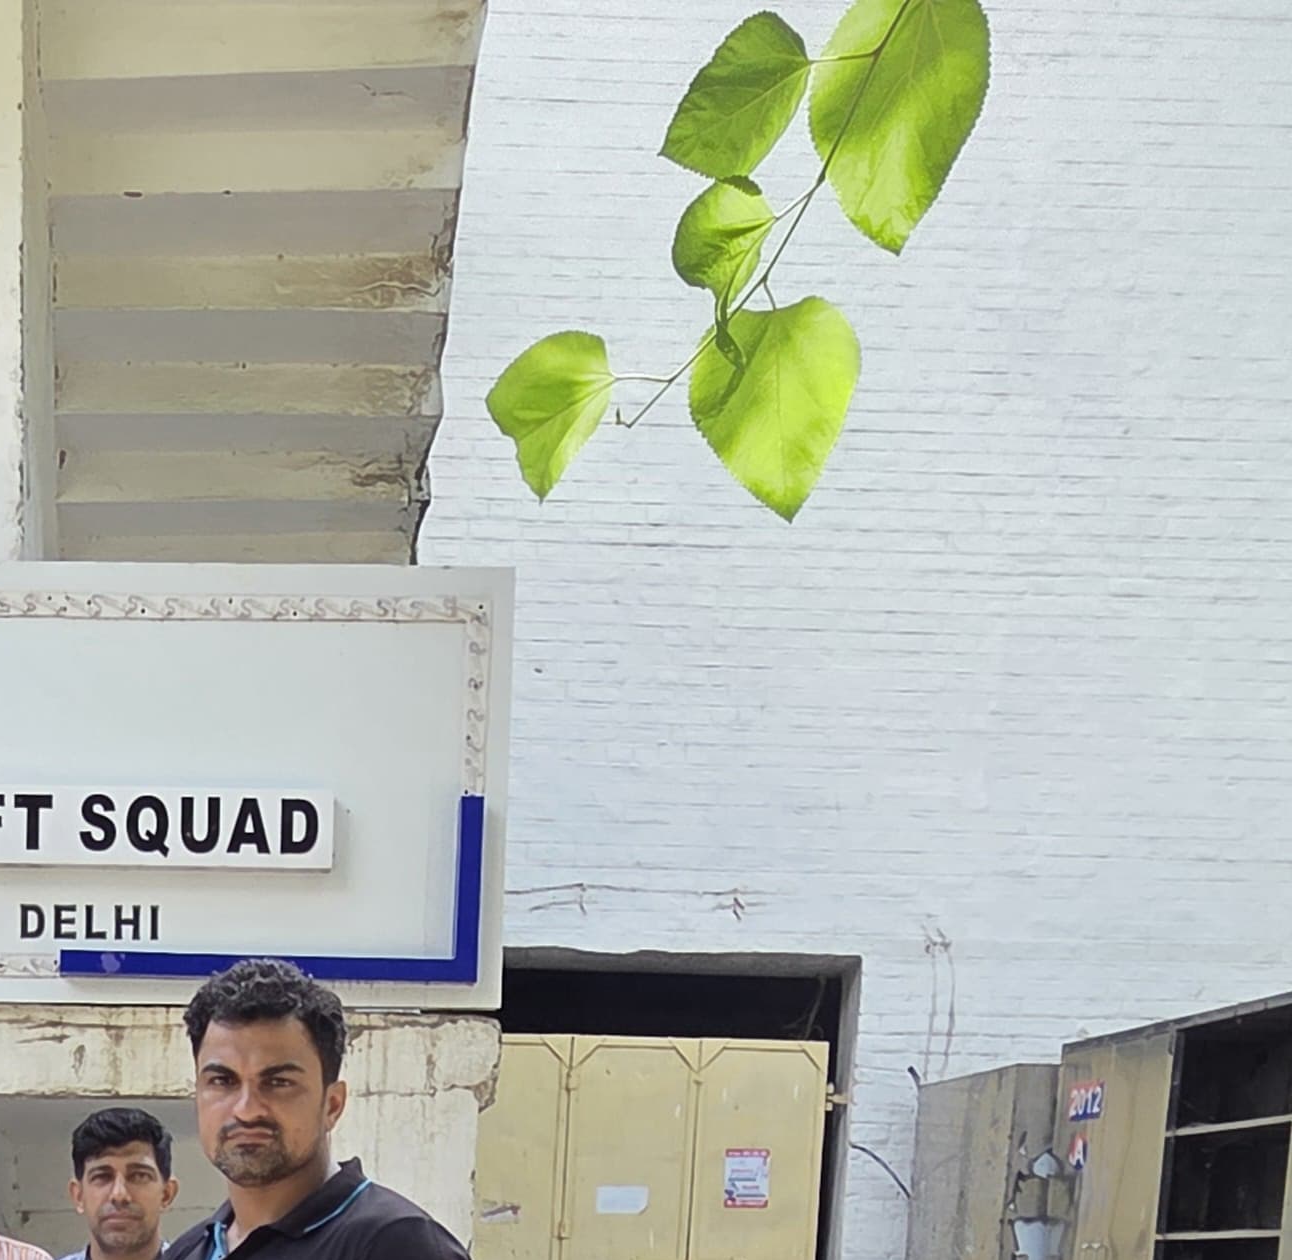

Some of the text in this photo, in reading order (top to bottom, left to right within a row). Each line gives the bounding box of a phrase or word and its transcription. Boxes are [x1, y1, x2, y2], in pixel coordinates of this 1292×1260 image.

[79, 793, 319, 858] SQUAD
[20, 903, 160, 941] DELHI
[1068, 1085, 1102, 1117] 2012
